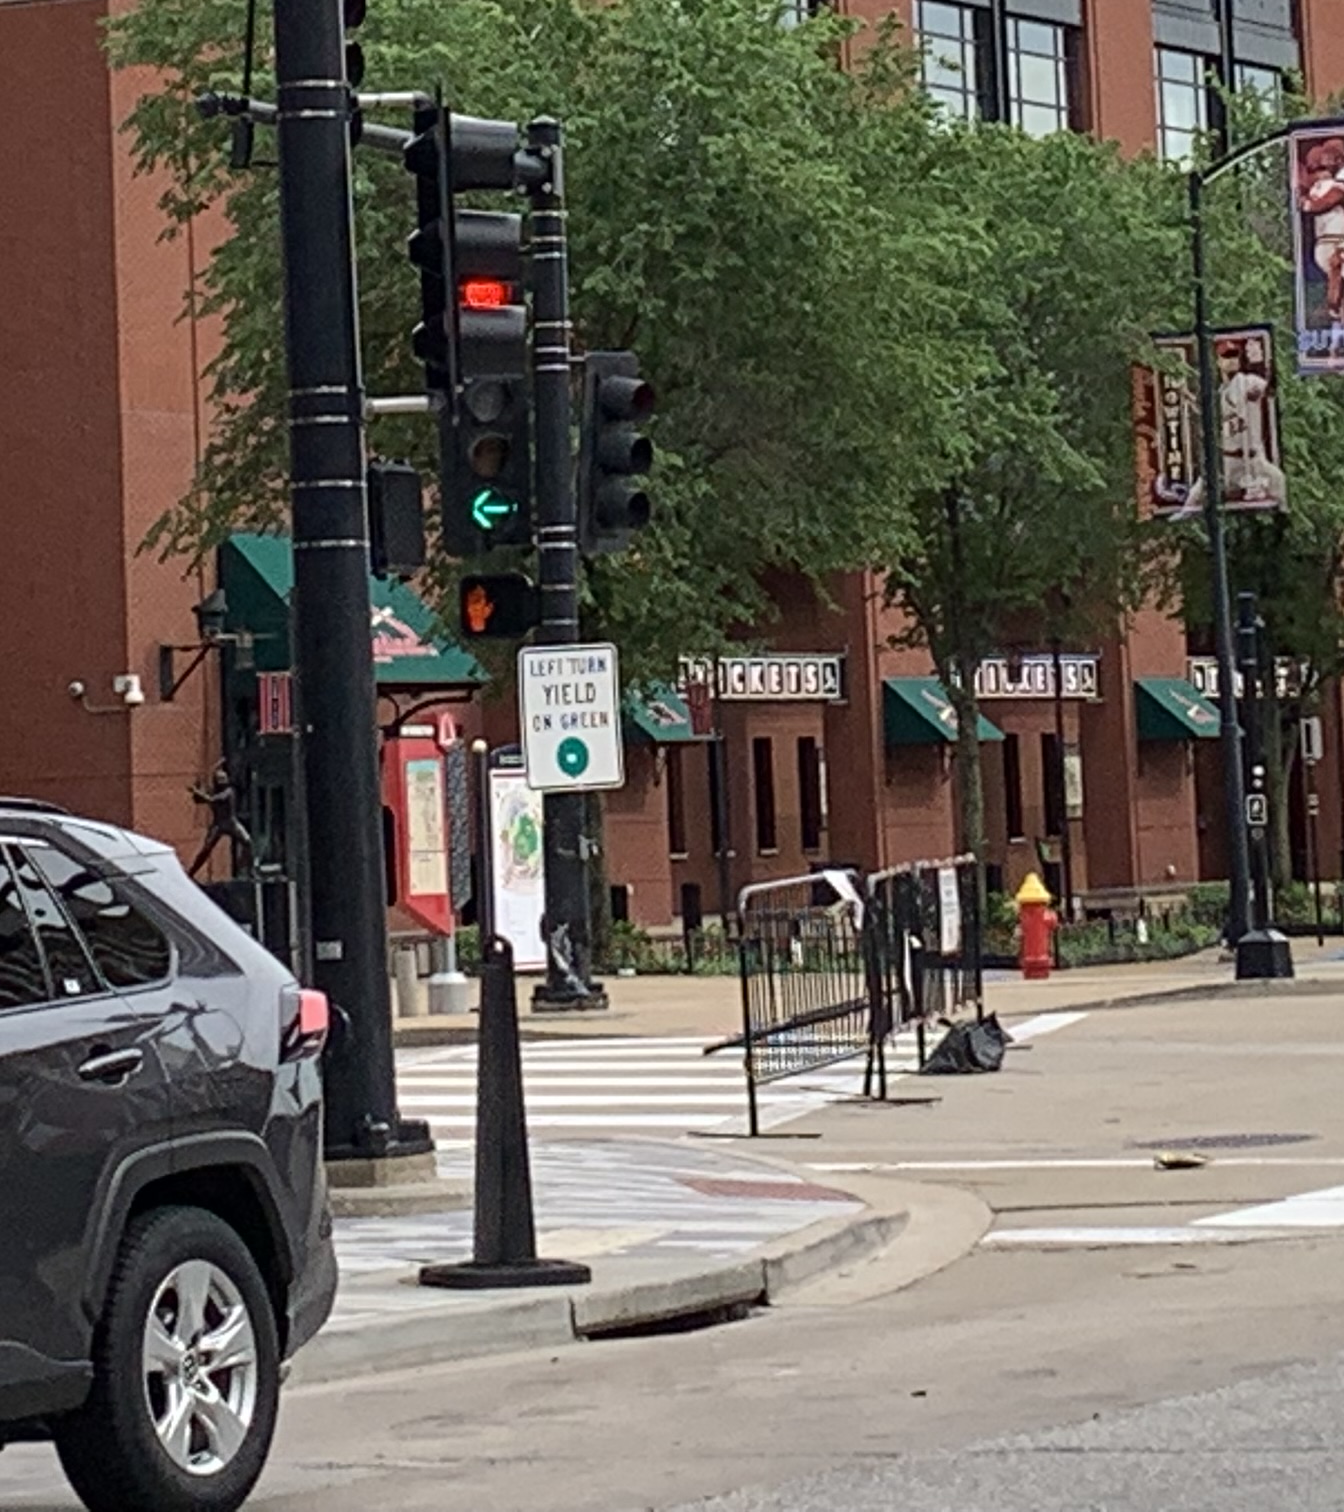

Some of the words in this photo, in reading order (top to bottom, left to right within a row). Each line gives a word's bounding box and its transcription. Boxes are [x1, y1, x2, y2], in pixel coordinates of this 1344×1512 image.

[530, 658, 563, 677] LEFT
[566, 655, 607, 676] TURN
[542, 682, 597, 705] YIELD
[532, 714, 552, 733] ON
[560, 711, 609, 730] GREEN
